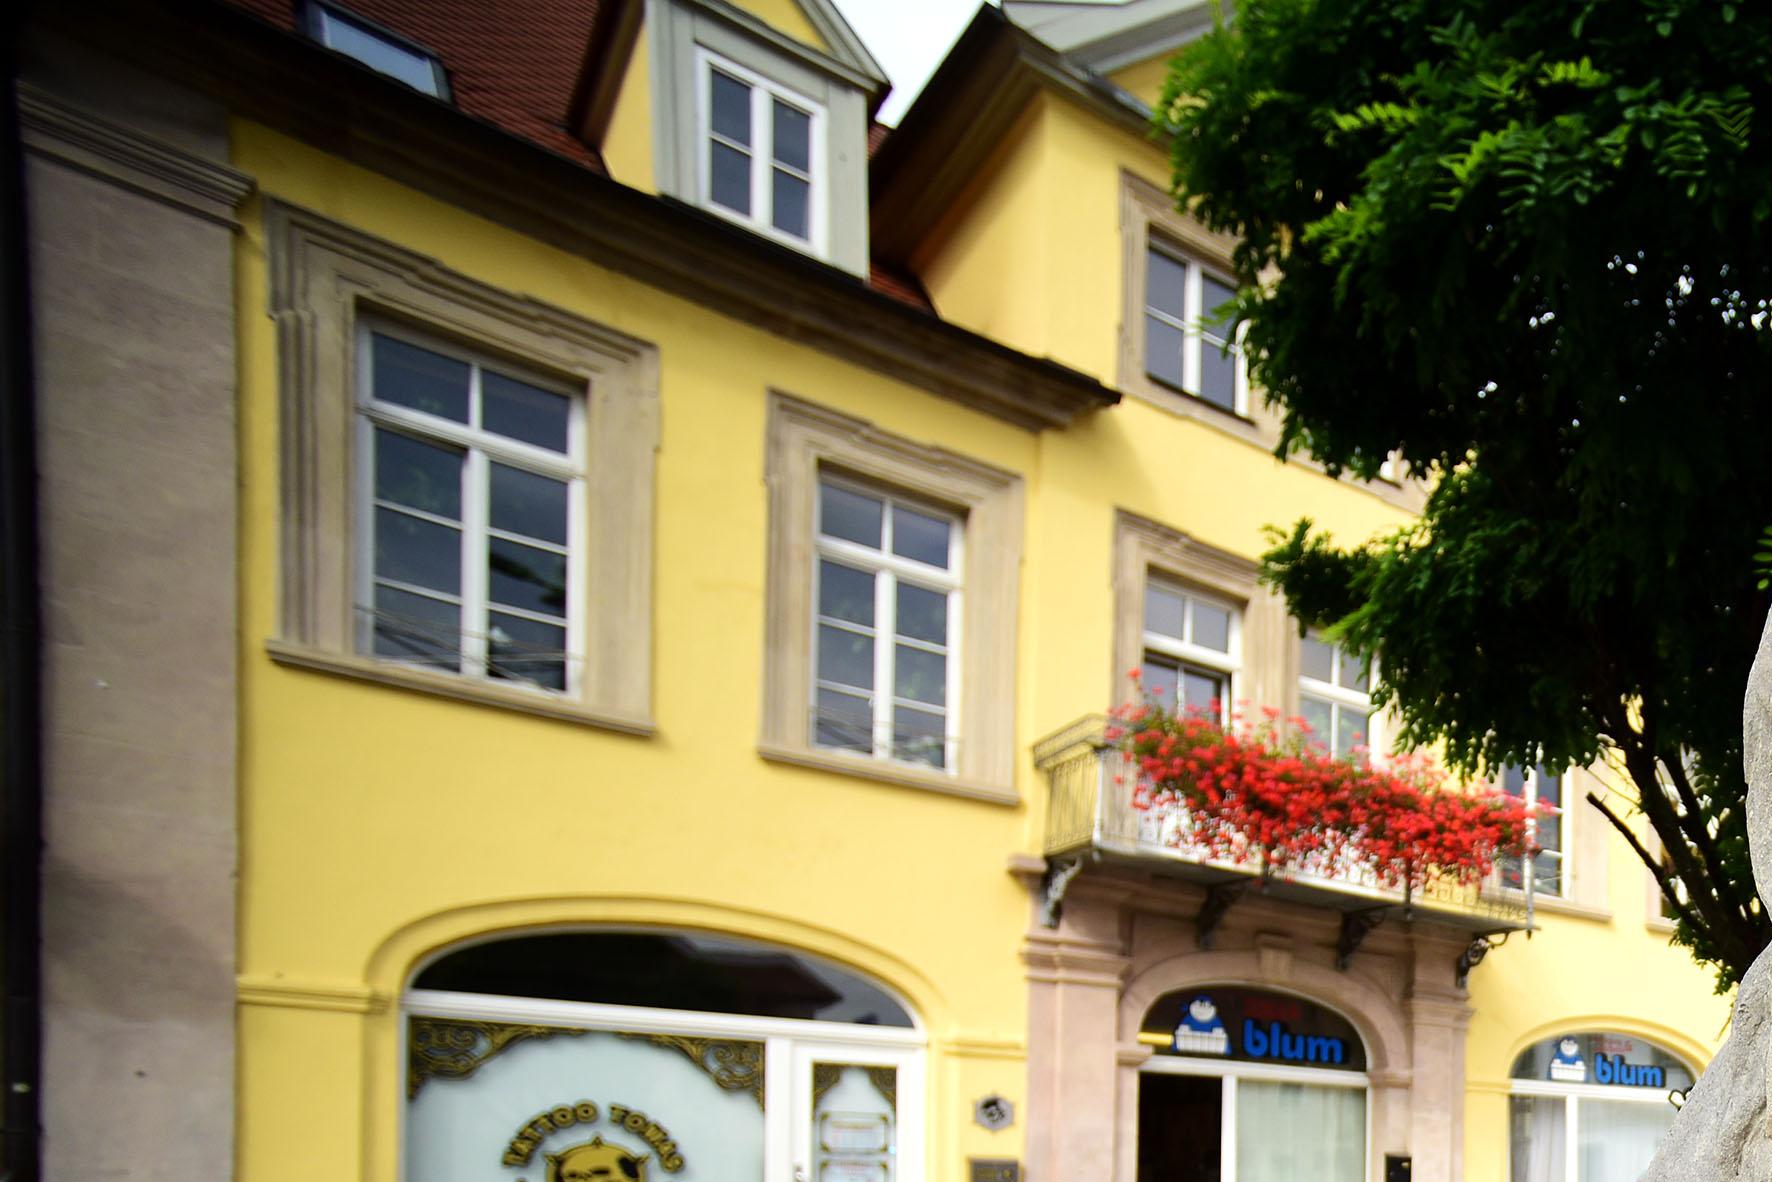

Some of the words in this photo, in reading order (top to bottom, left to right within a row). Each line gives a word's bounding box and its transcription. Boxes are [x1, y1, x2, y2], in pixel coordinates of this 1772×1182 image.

[1243, 1018, 1344, 1064] blum
[1595, 1053, 1663, 1087] blum
[502, 1100, 599, 1169] TATTOO
[608, 1102, 685, 1174] TOMAS
